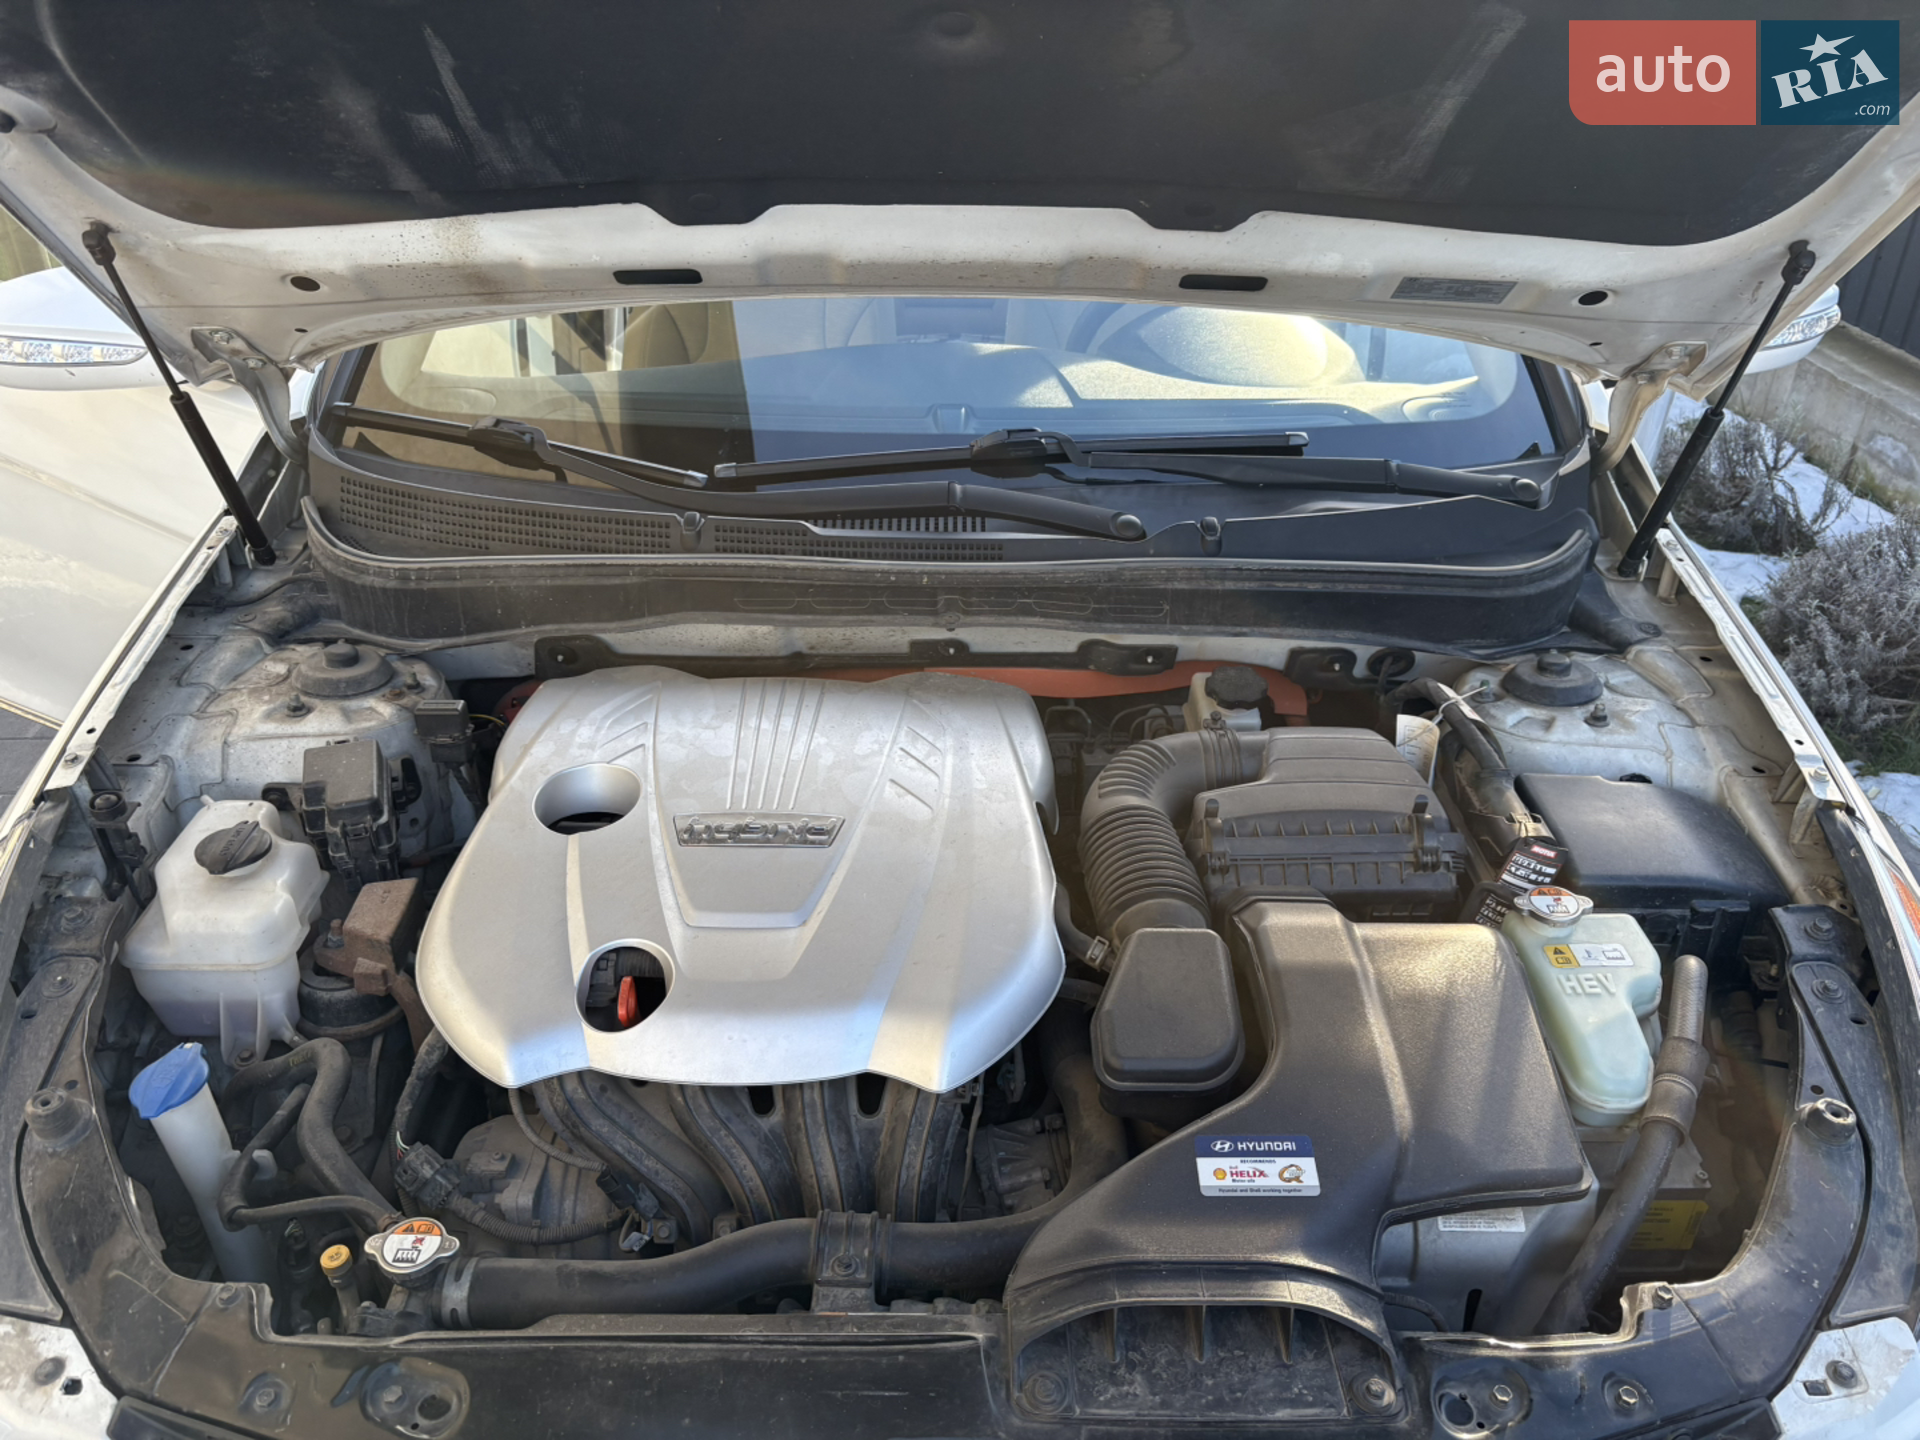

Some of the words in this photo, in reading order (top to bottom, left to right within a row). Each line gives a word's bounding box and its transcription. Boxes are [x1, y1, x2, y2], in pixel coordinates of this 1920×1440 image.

[1557, 973, 1617, 996] HEV
[1237, 1141, 1296, 1151] HYUNDAI
[1229, 1170, 1266, 1178] HELIX
